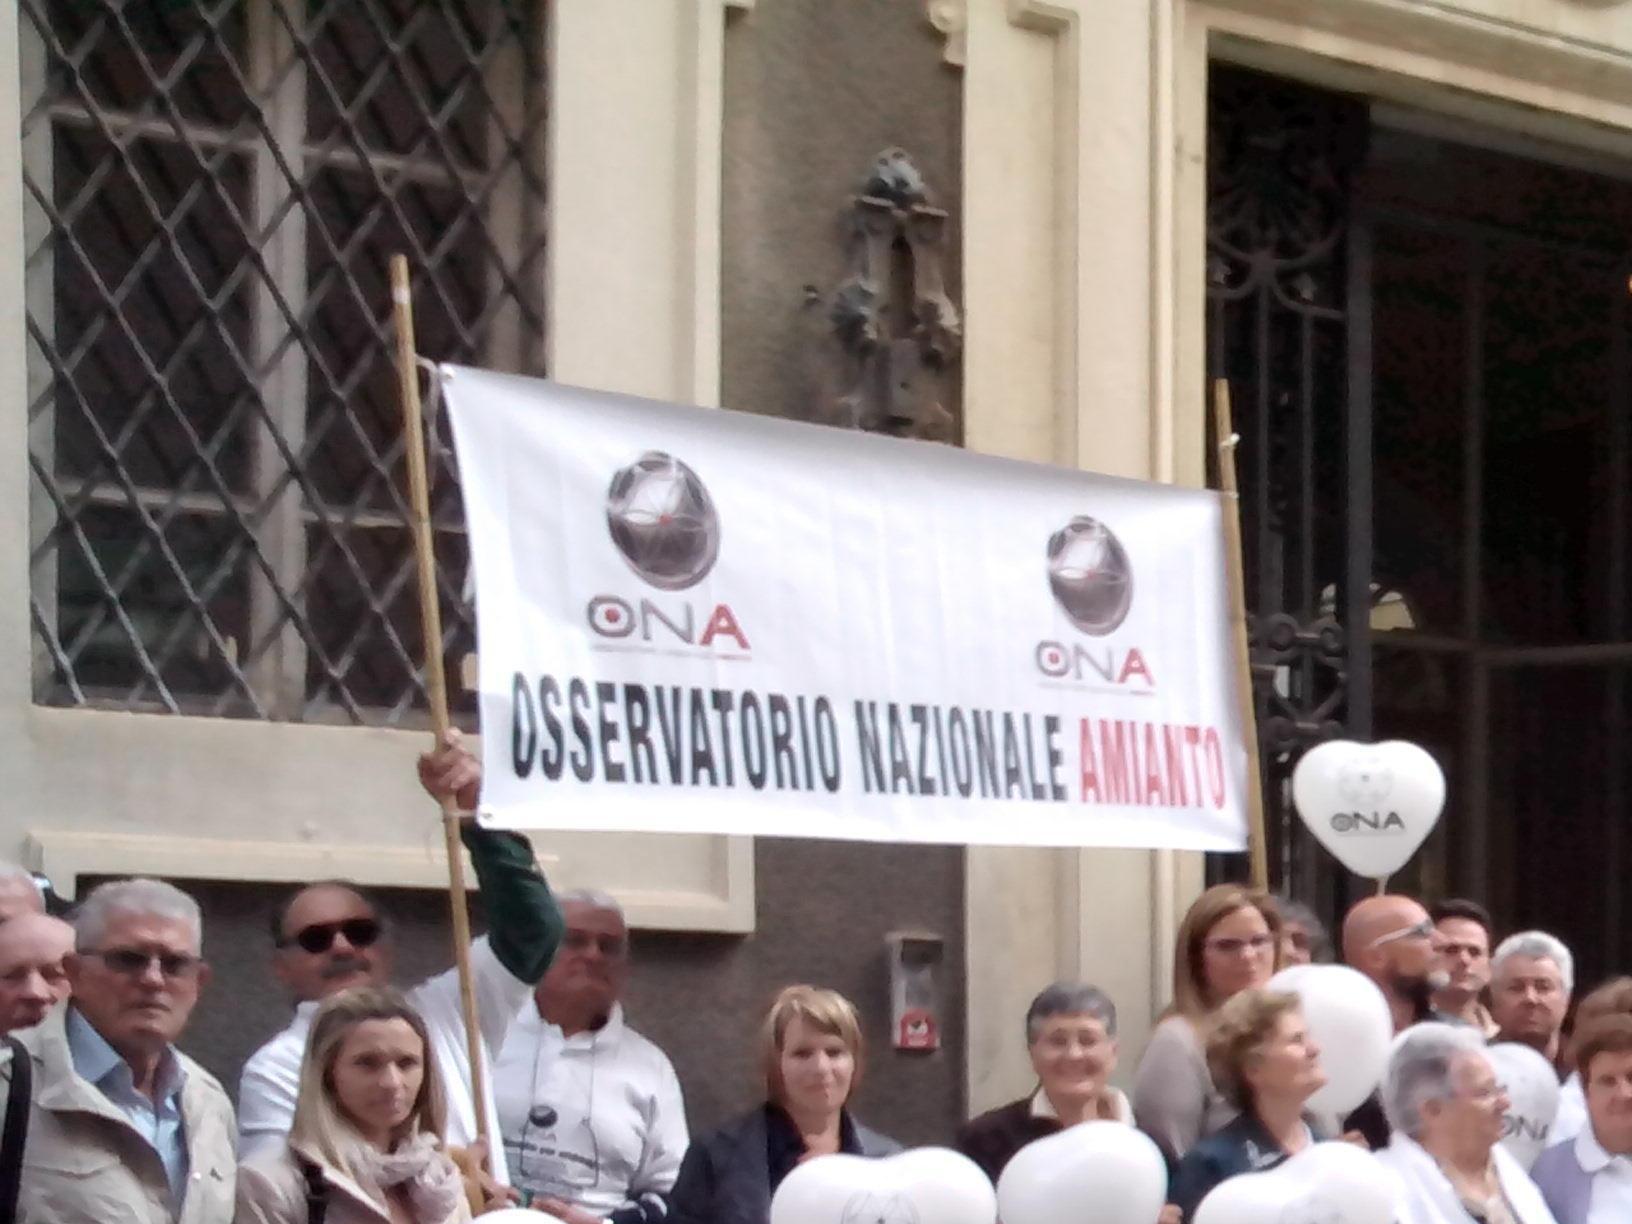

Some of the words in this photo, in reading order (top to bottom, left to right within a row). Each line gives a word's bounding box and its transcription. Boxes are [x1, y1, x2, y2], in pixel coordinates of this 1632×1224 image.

[587, 595, 752, 651] ONA
[1034, 640, 1155, 686] ONA
[511, 671, 842, 793] OSSERVATORIO
[854, 699, 1068, 801] NAZIONALE
[1079, 717, 1225, 810] AMIANTO
[1329, 811, 1406, 833] ONA
